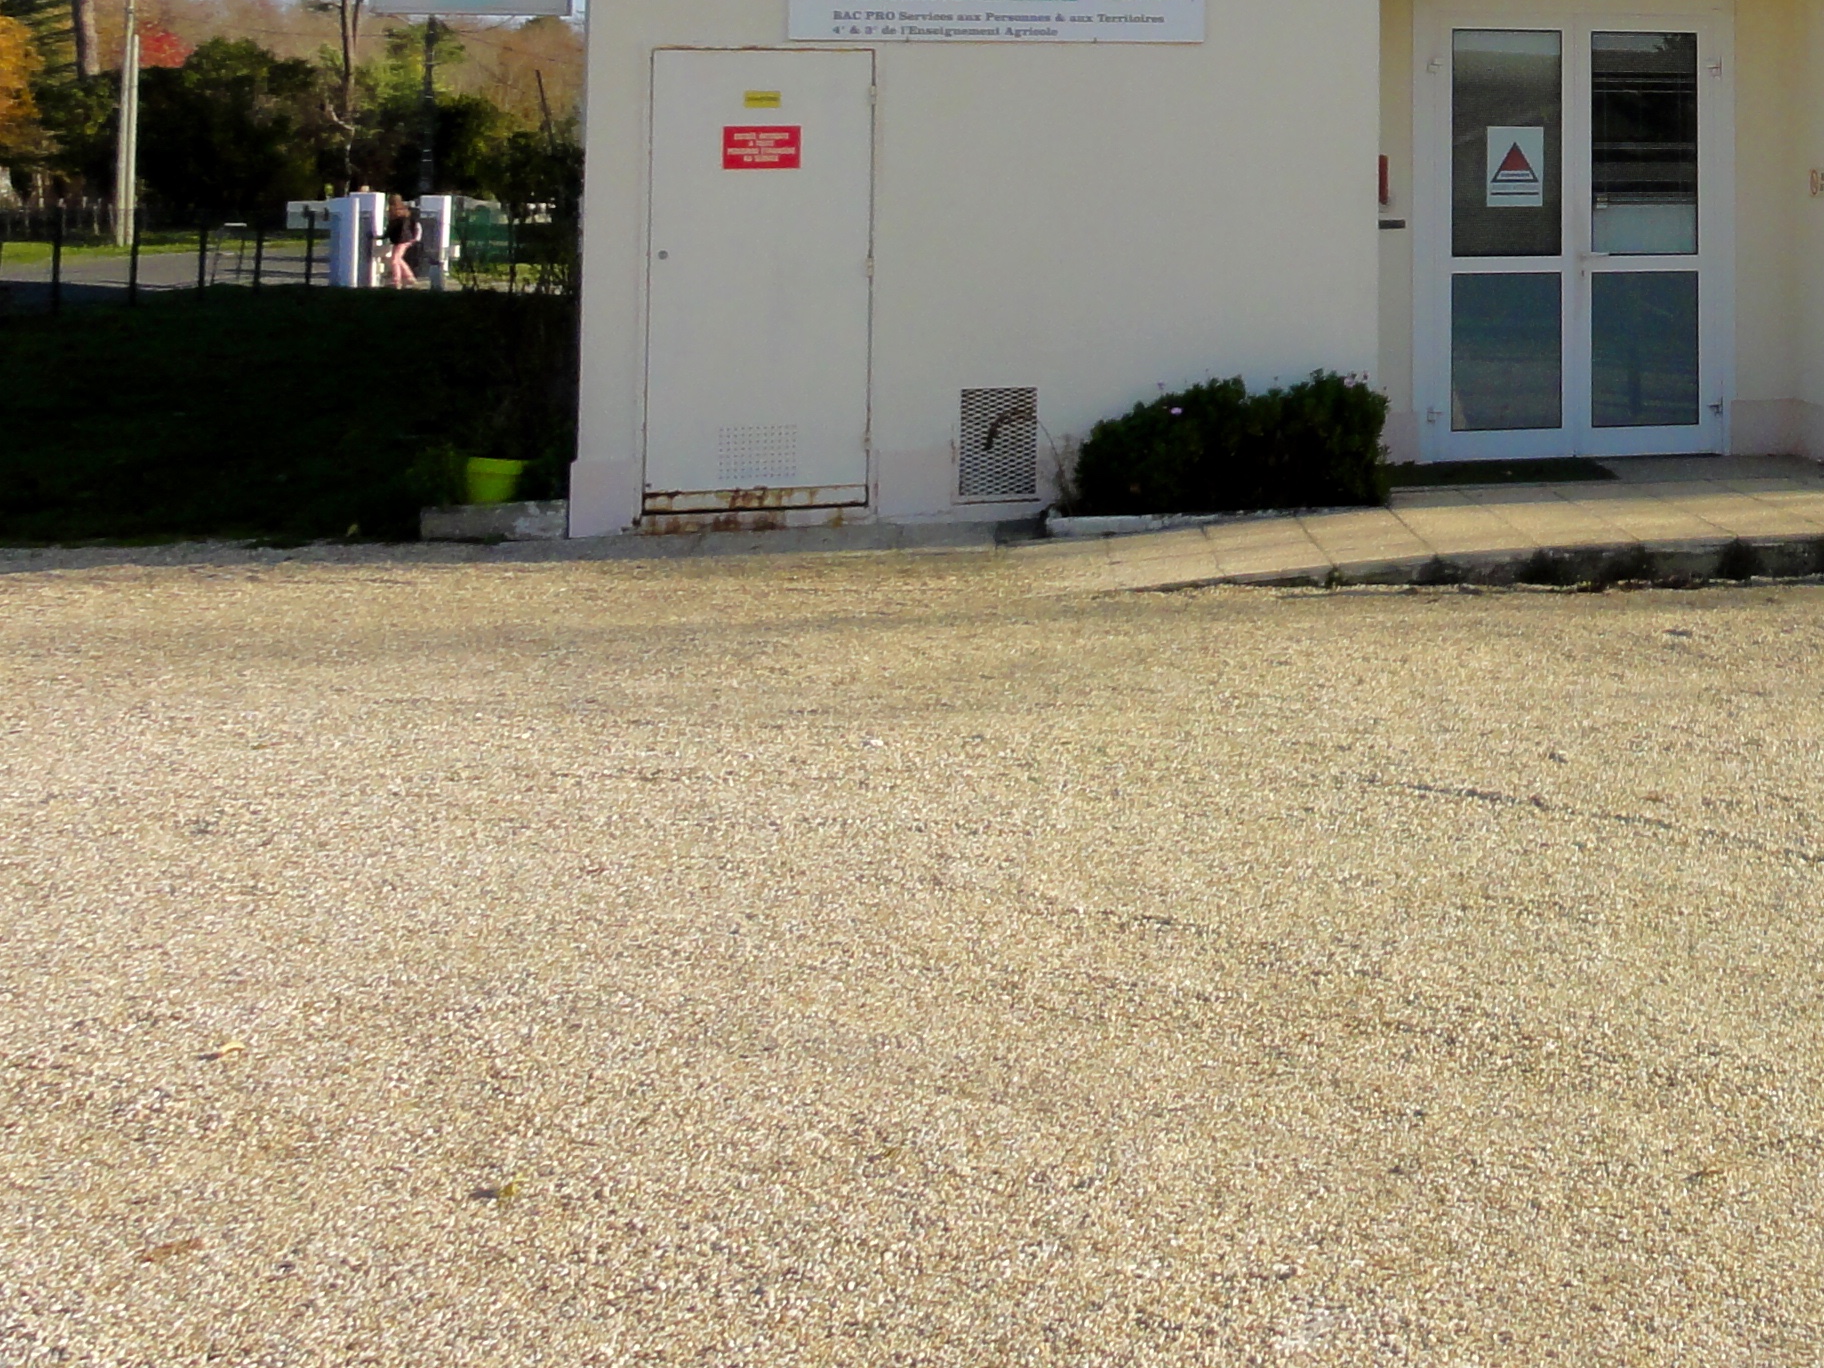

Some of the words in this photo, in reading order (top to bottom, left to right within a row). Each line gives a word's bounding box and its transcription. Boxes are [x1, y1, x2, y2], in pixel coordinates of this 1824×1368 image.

[832, 10, 862, 21] BAC
[865, 10, 895, 21] PRO
[899, 11, 953, 22] Services
[956, 13, 982, 22] aux
[985, 12, 1051, 23] Personnes
[1069, 14, 1093, 23] aux
[1097, 13, 1165, 24] Territoires
[1004, 27, 1059, 38] Agricole
